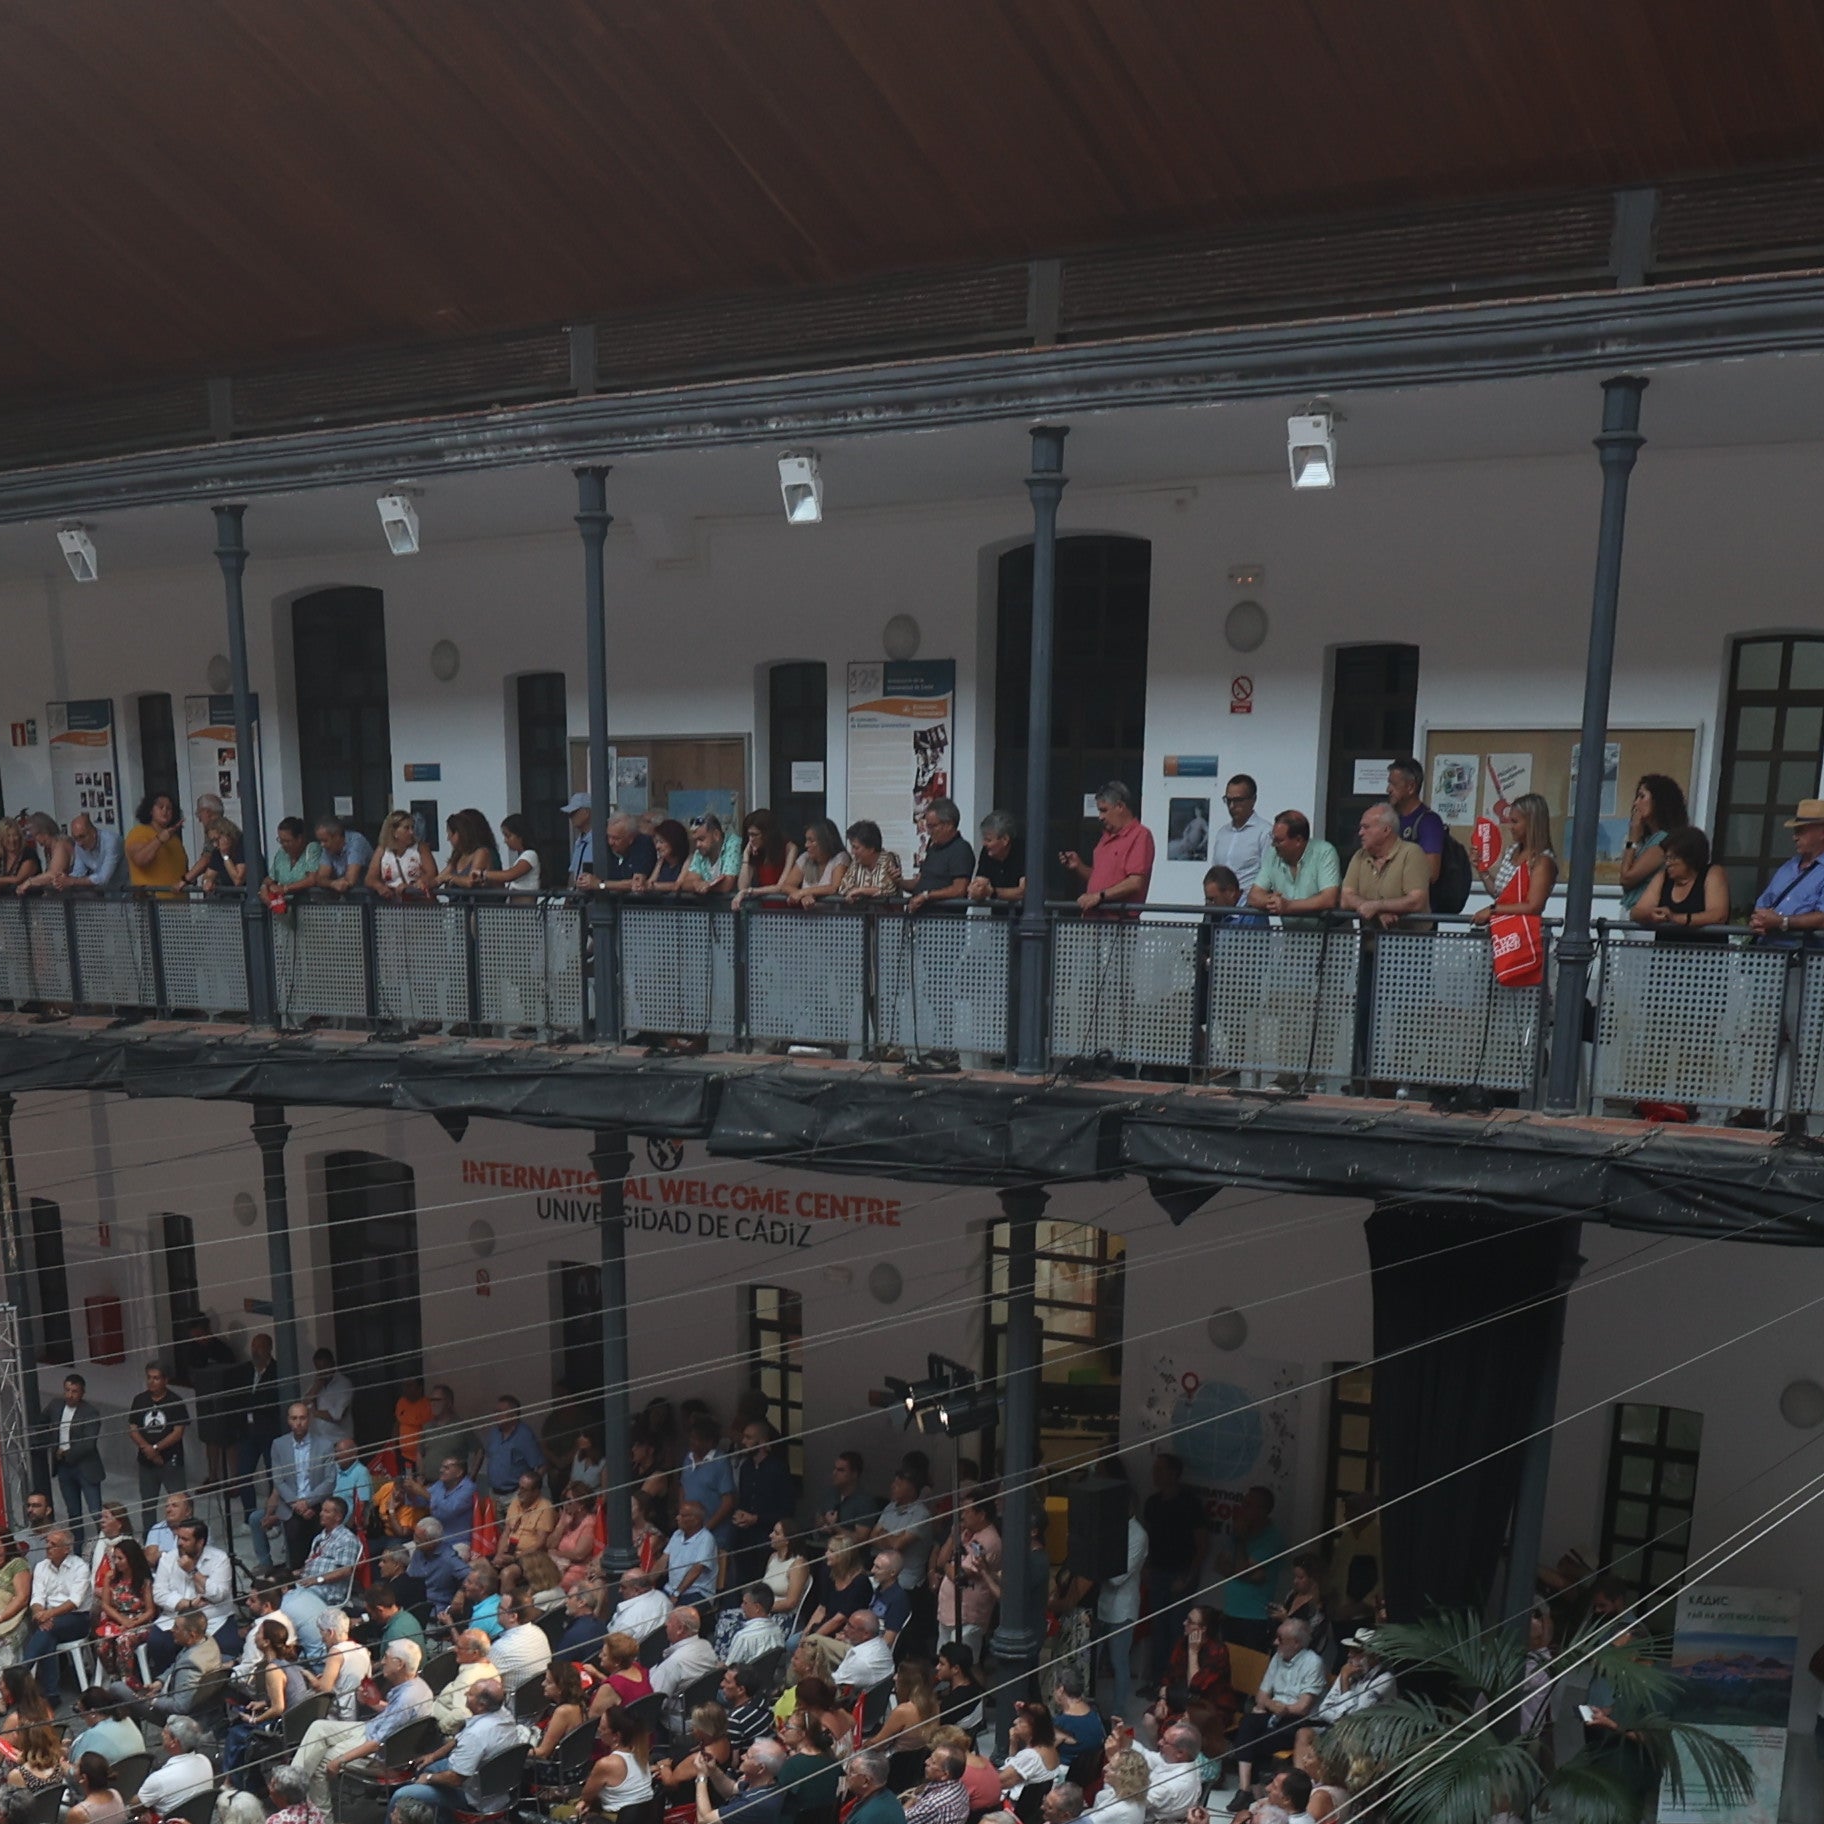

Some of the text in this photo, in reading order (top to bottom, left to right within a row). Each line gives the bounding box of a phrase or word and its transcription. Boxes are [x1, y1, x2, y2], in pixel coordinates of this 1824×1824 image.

[462, 1159, 902, 1227] INTERNATIOAL WELCOME CENTRE
[536, 1196, 692, 1235] UNIVESIDAD
[698, 1213, 730, 1239] DE
